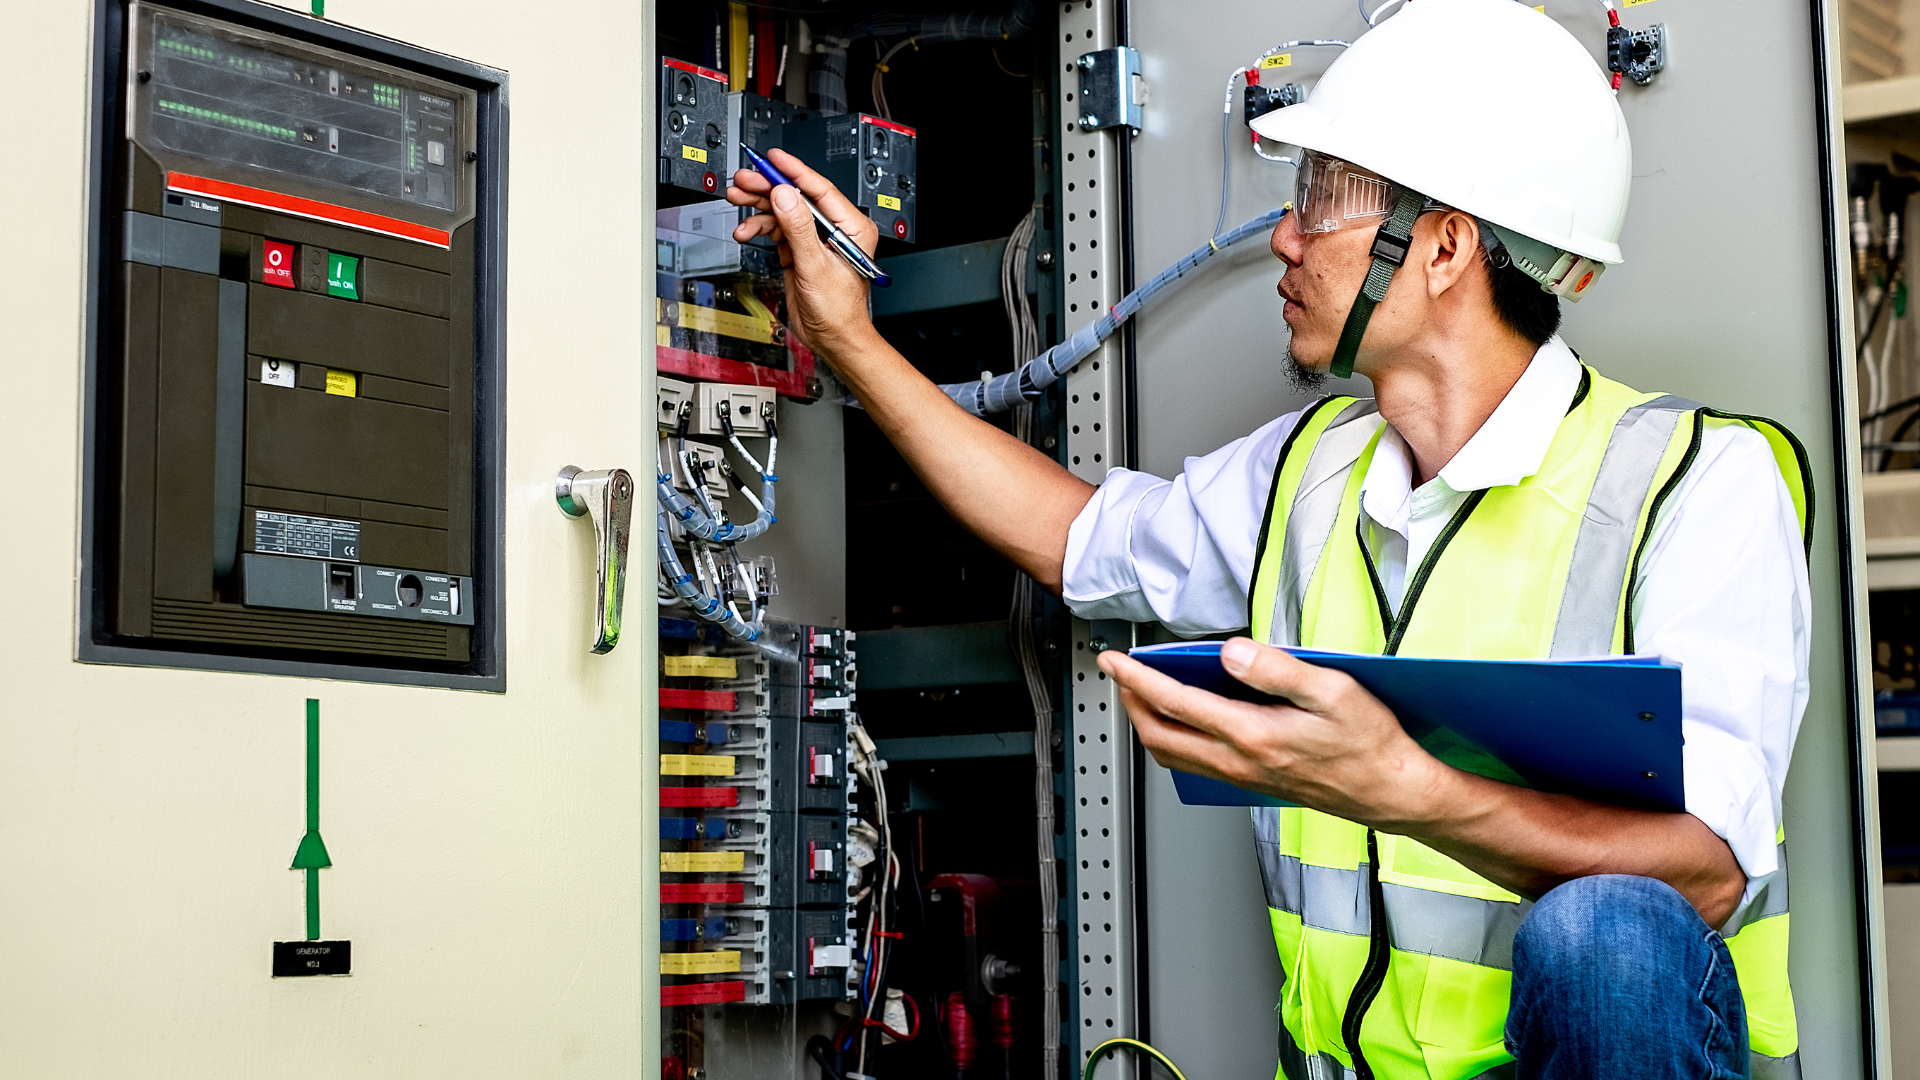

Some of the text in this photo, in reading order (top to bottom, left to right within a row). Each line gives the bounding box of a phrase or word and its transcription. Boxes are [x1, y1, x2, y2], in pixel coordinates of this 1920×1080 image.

[690, 149, 699, 159] Q1
[202, 202, 219, 212] Reset
[277, 268, 290, 277] OFF
[328, 278, 354, 290] ush ON
[268, 372, 280, 380] OFF
[326, 375, 348, 384] HARGED
[326, 382, 345, 391] SPRING
[425, 575, 448, 583] CONNECTED
[420, 608, 450, 616] DISCONNECTED
[296, 947, 331, 955] GENERATOR
